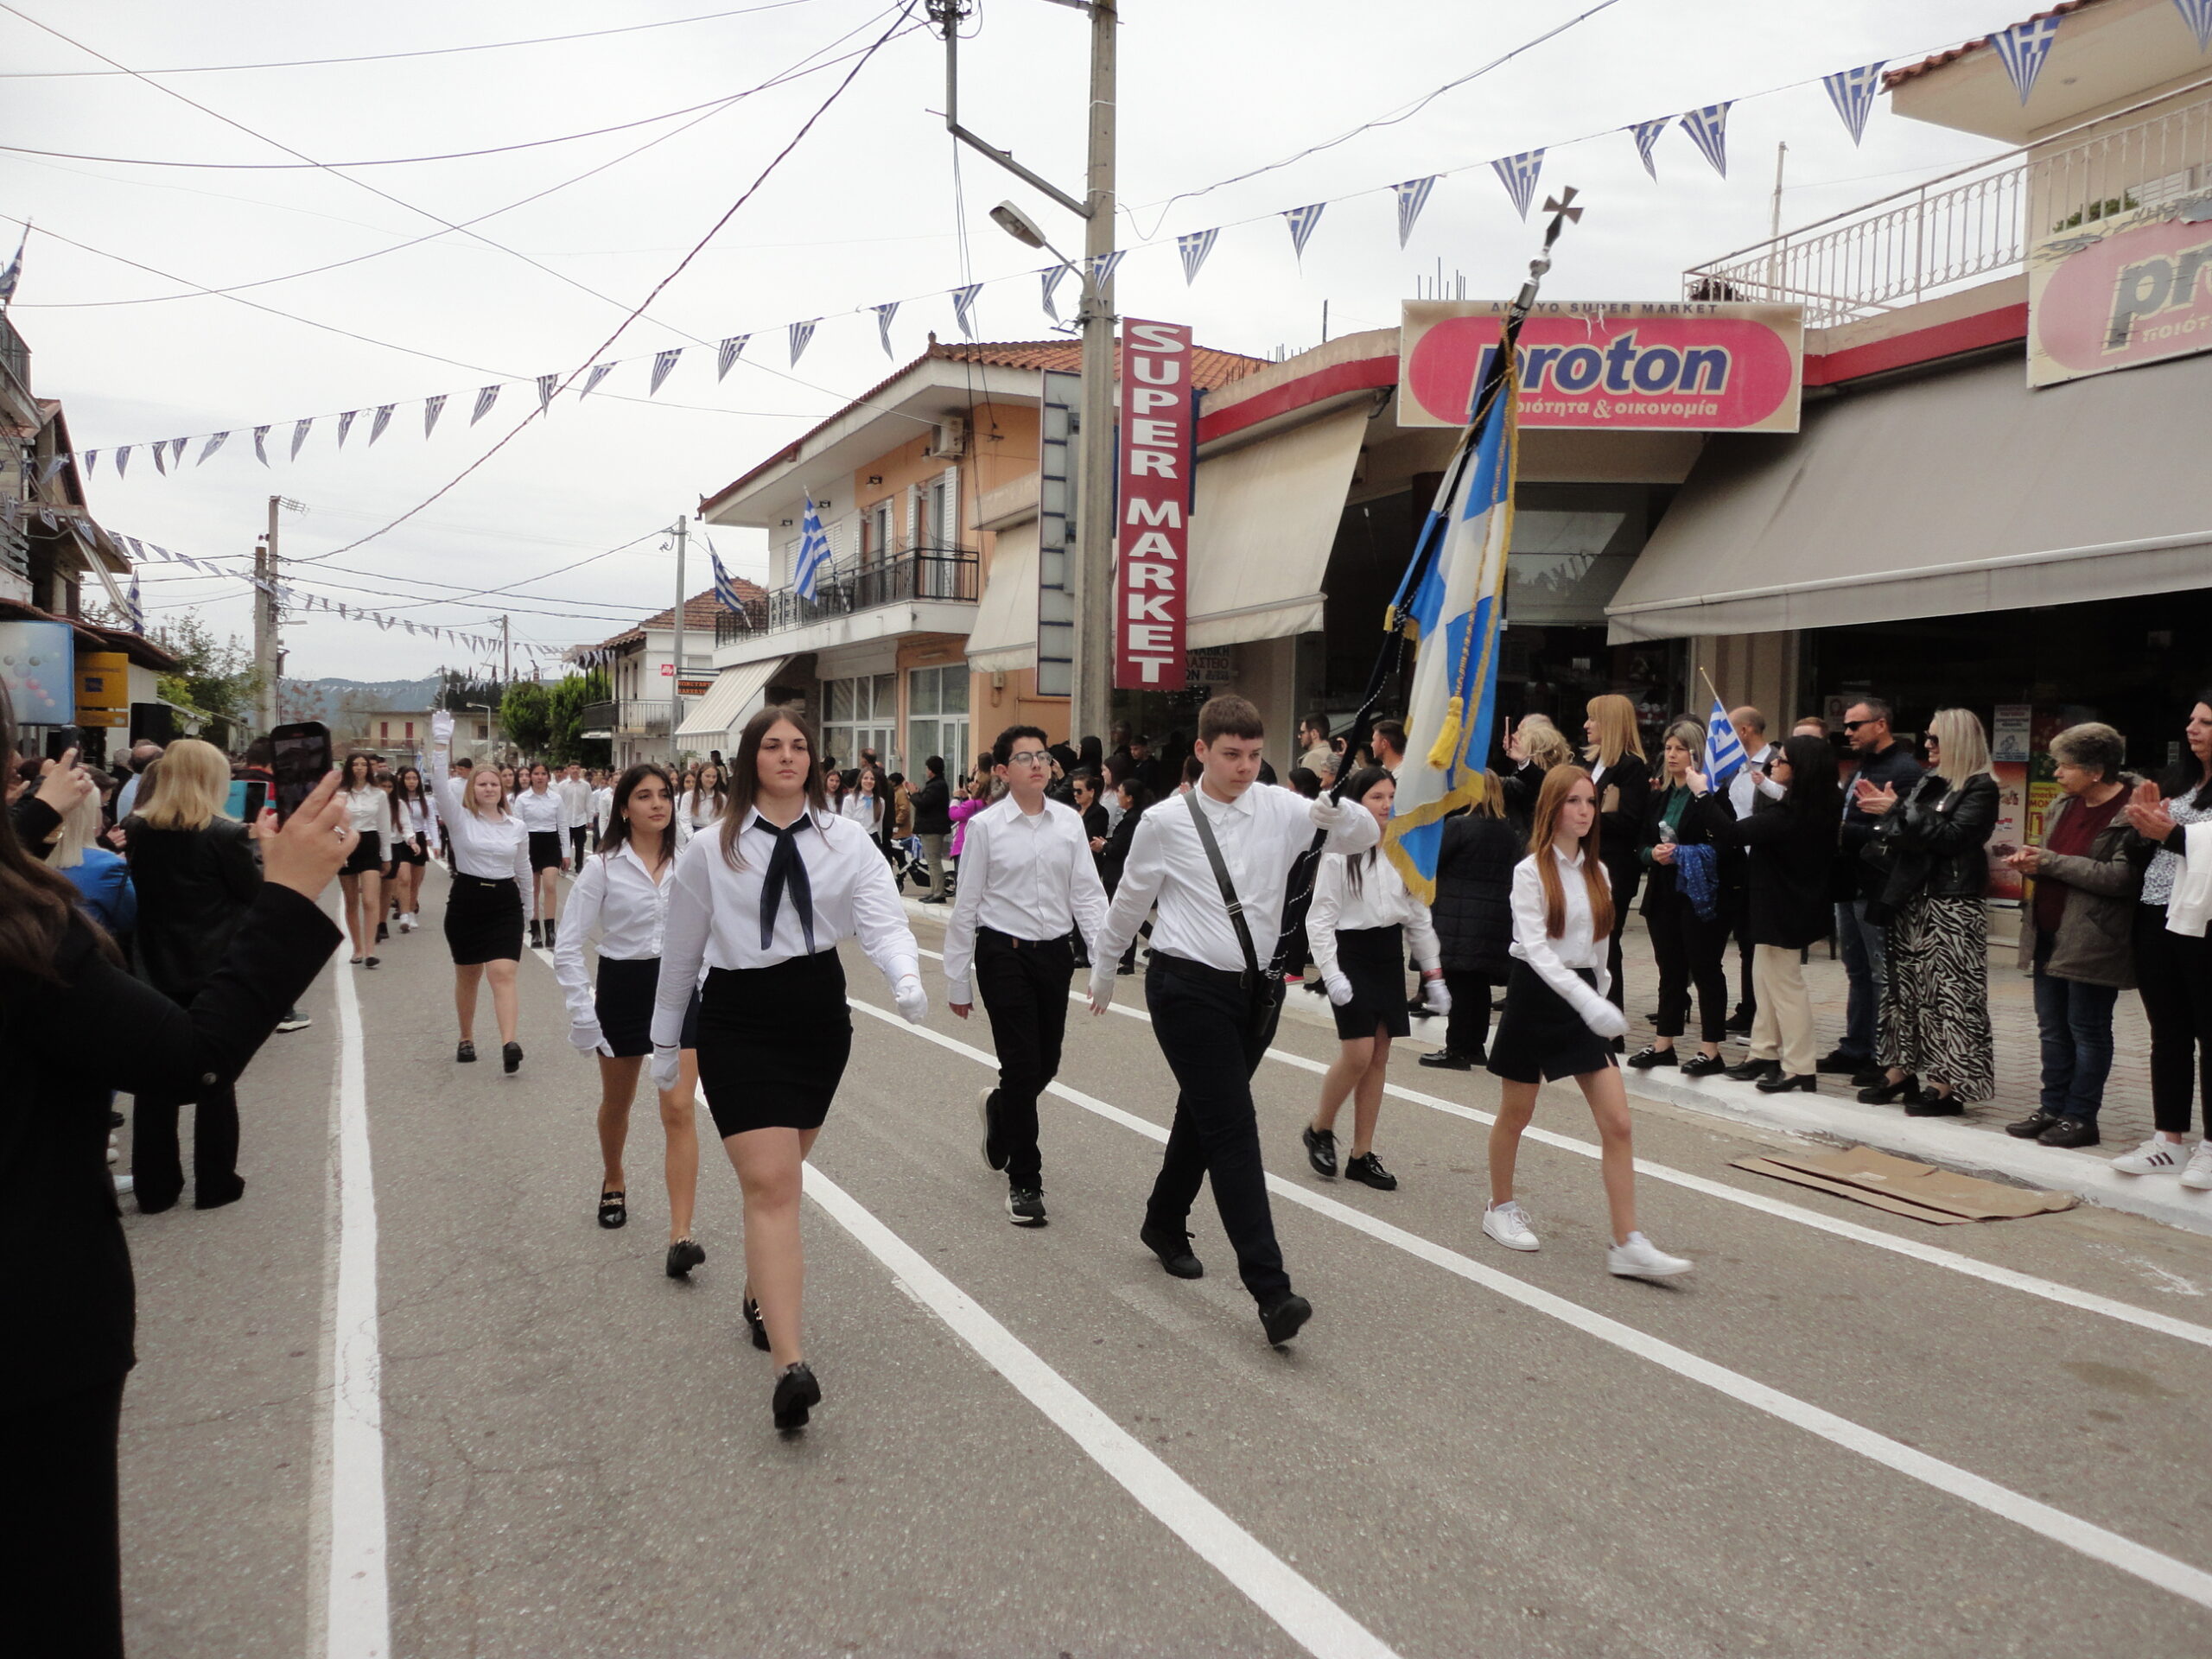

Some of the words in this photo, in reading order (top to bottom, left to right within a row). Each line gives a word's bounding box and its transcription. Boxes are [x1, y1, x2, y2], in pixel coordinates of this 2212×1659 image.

[1491, 302, 1560, 313] ΔΙΥΟ
[1571, 302, 1632, 314] SUPER
[1643, 303, 1718, 314] MARKET
[2101, 241, 2212, 355] pr
[2142, 313, 2212, 343] ποιότ
[1129, 325, 1185, 480] SUPER
[1517, 398, 1590, 416] οιότητα
[1615, 399, 1718, 418] οικονομία
[1127, 498, 1182, 683] MARKET
